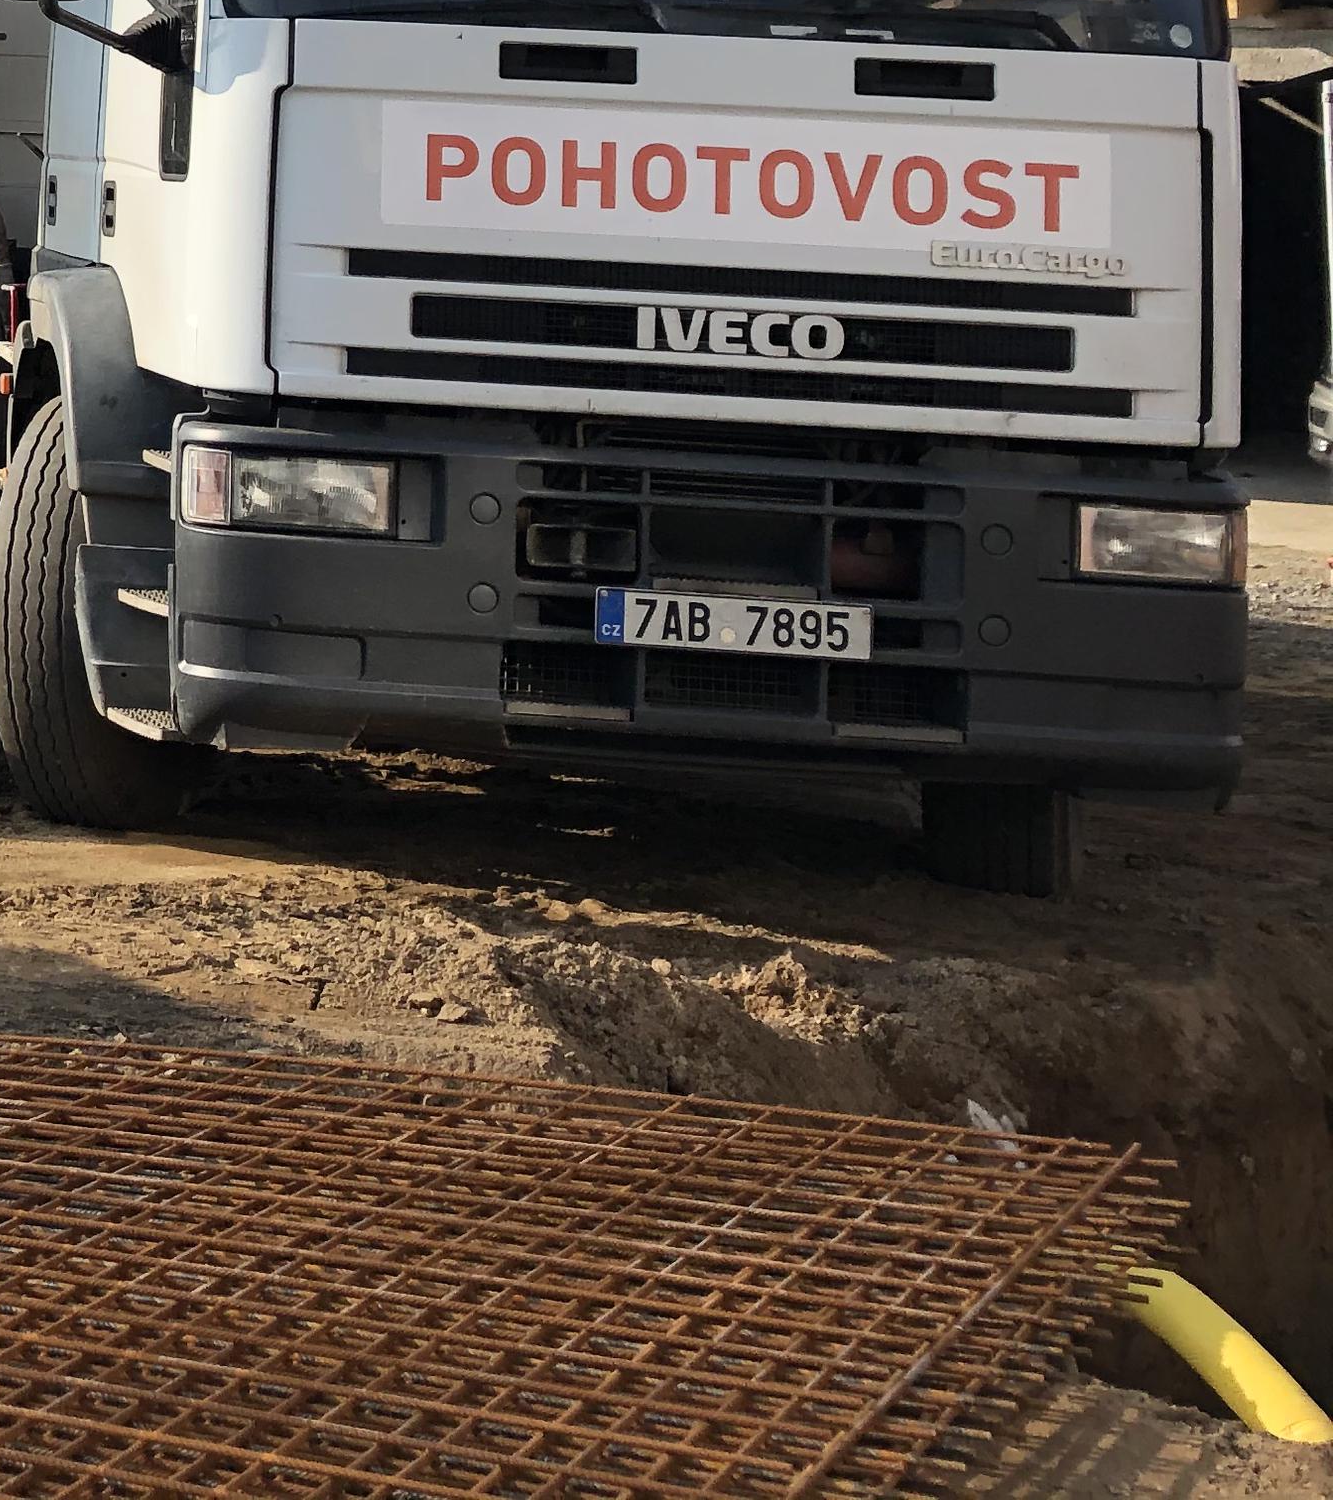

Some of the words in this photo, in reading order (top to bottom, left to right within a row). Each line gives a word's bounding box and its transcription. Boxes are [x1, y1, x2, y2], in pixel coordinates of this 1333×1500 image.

[425, 132, 1080, 233] POHOTOVOST
[930, 239, 1129, 278] EuroCargo
[636, 305, 846, 360] IVECO
[601, 622, 621, 637] CZ
[635, 597, 711, 643] 7AB
[745, 605, 850, 653] 7895
